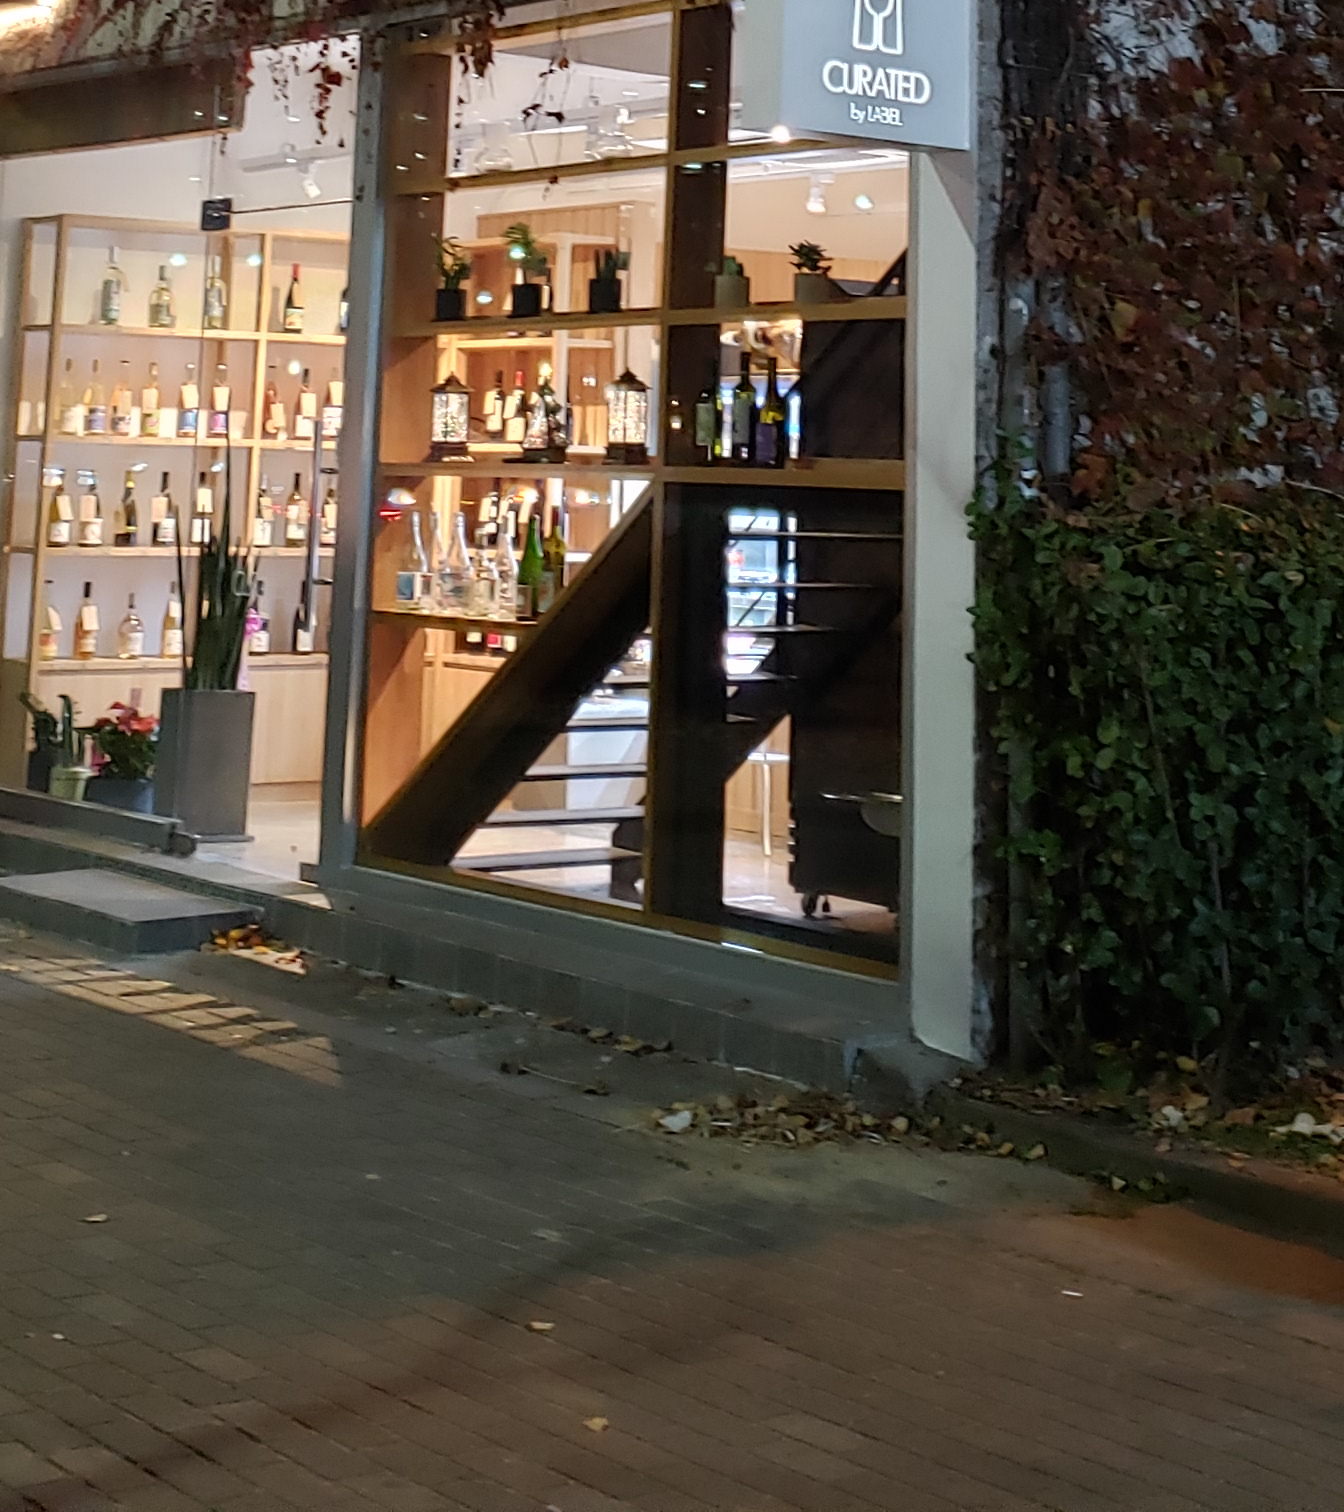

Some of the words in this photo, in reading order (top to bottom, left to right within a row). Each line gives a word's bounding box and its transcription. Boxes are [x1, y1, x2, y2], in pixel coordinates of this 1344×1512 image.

[822, 60, 932, 105] CURATED
[849, 102, 866, 124] by
[867, 105, 904, 126] LABEL
